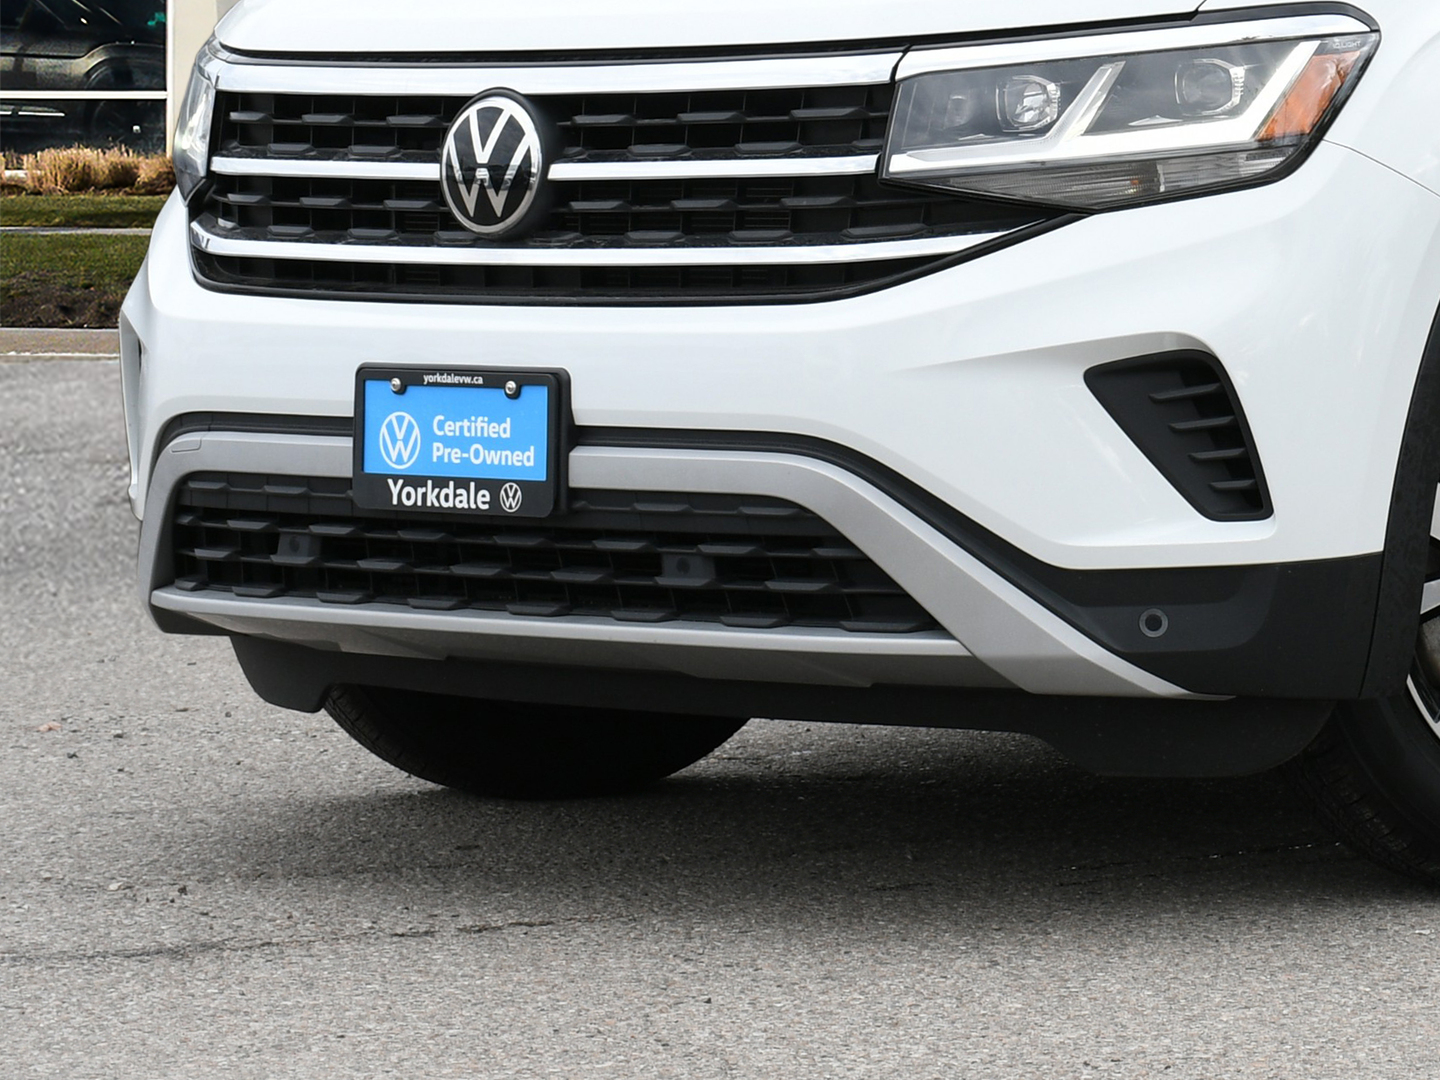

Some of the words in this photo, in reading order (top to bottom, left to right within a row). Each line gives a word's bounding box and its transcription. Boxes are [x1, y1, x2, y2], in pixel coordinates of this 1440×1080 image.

[423, 373, 484, 385] yorkdalevw.ca
[432, 415, 511, 438] Certified
[432, 442, 535, 467] Pre-Owned
[387, 478, 491, 510] Yorkdale
